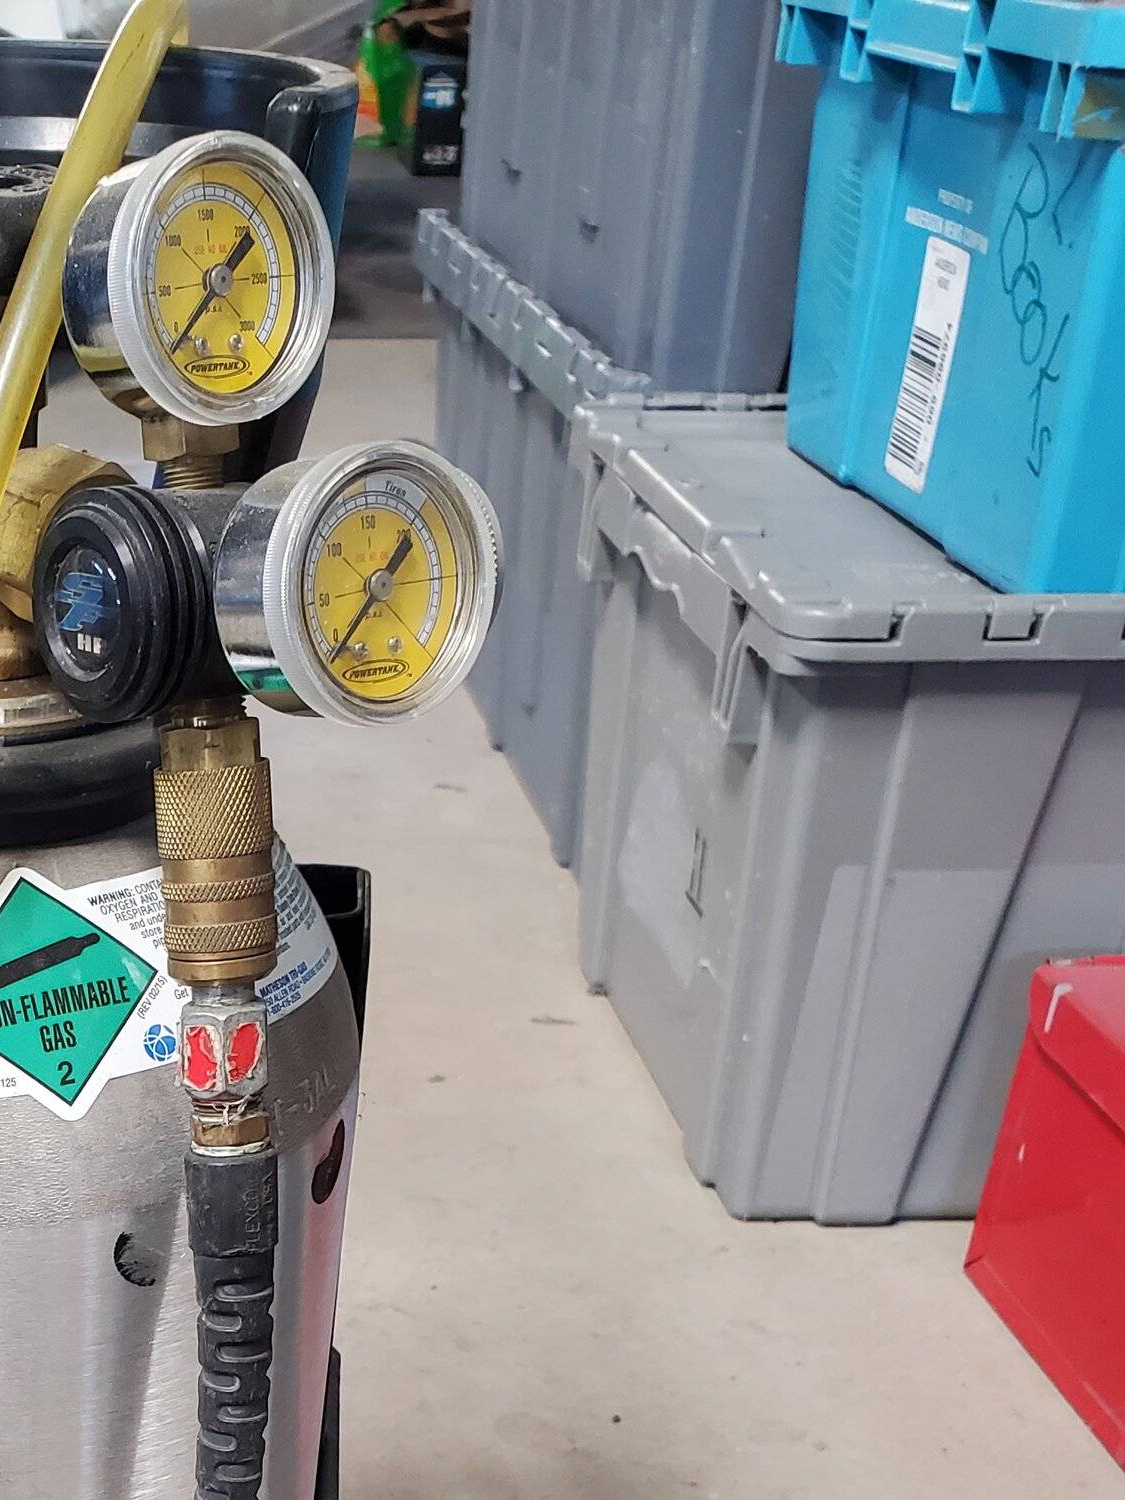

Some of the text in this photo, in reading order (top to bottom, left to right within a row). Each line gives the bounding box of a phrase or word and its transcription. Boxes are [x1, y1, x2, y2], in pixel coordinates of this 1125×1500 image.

[198, 208, 214, 221] 1500
[165, 234, 182, 247] 1000
[251, 272, 268, 285] 2500
[159, 285, 172, 297] 500
[173, 322, 179, 333] 0
[239, 320, 255, 332] 3000
[190, 359, 240, 374] POWERTANK
[385, 480, 407, 498] Tires
[360, 515, 376, 531] 150
[326, 542, 343, 558] 100
[319, 593, 330, 607] 50
[332, 628, 339, 642] 0
[349, 666, 400, 680] POWERTANK
[87, 887, 134, 907] WARNING:
[100, 891, 159, 916] OXYGEN AND
[115, 900, 166, 923] RESPIRATIO
[129, 913, 166, 931] and unde
[141, 926, 162, 939] store
[173, 987, 190, 1001] Get
[39, 1020, 78, 1053] GAS
[57, 1060, 76, 1087] 2
[0, 1077, 17, 1088] 125
